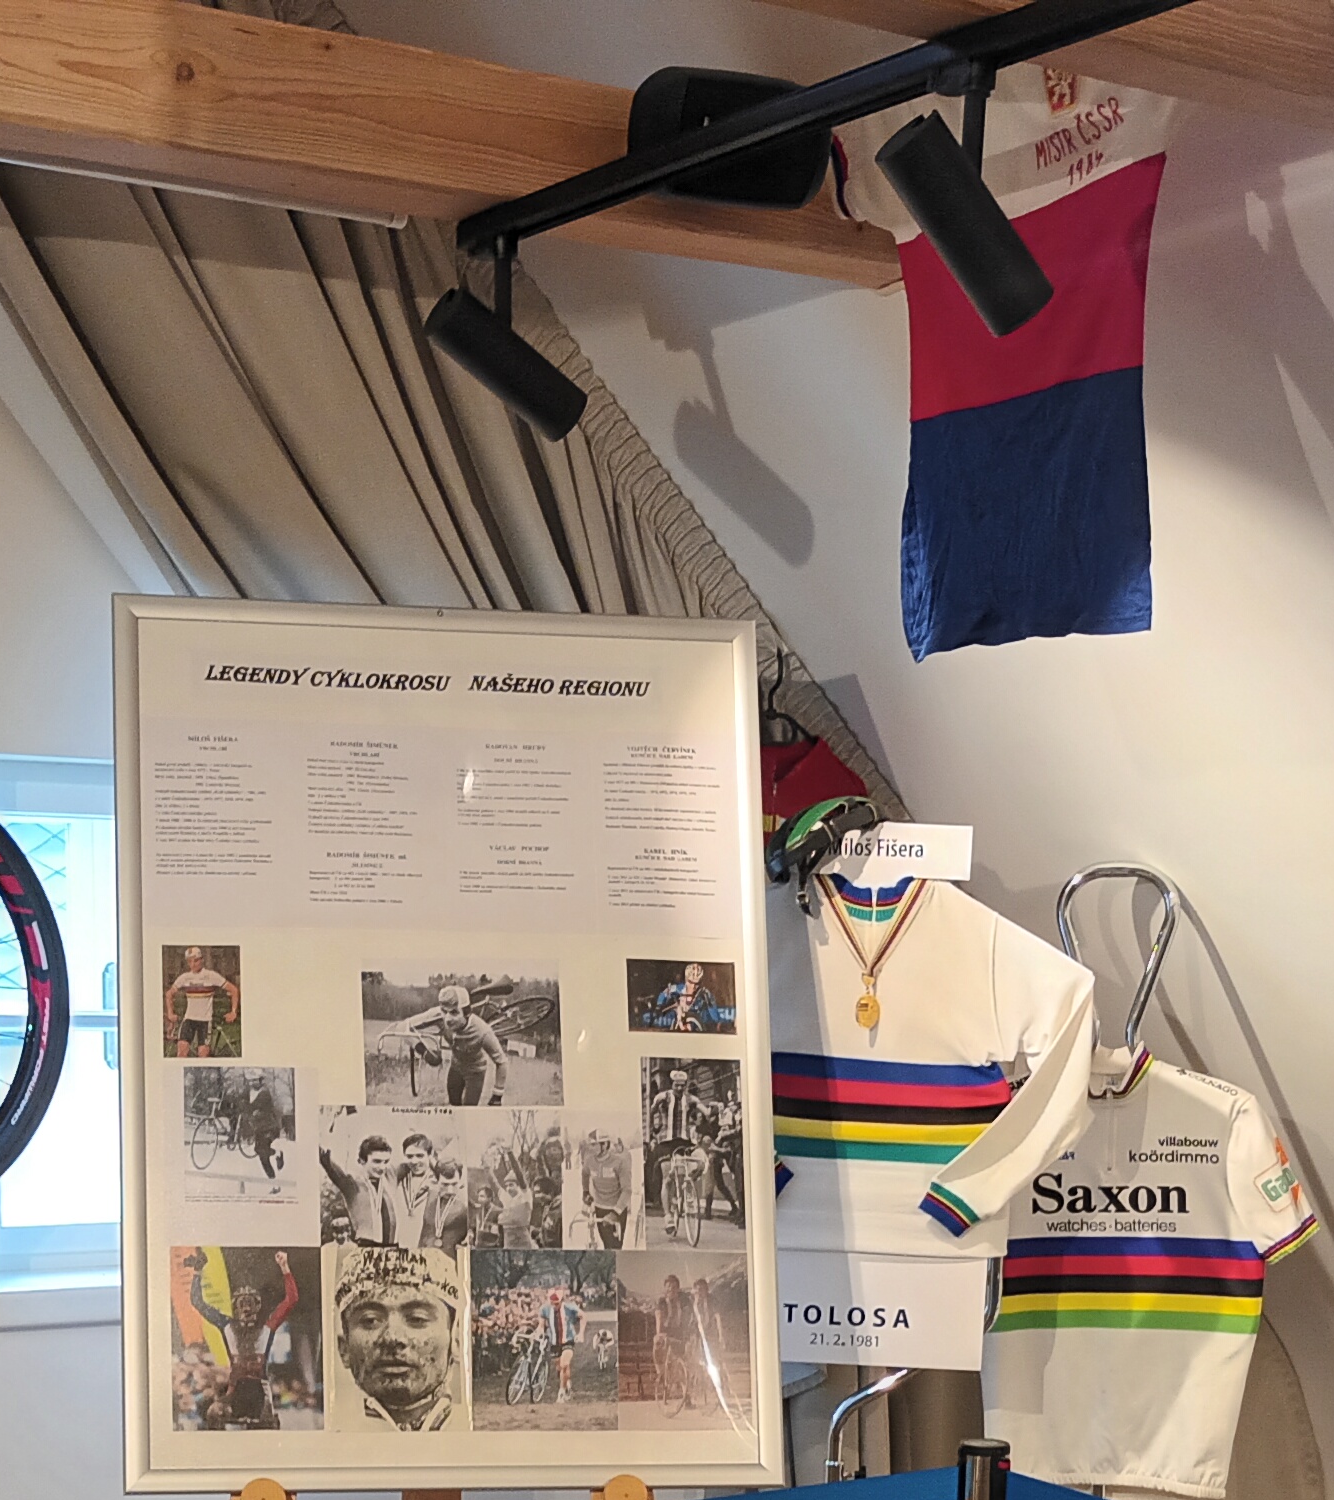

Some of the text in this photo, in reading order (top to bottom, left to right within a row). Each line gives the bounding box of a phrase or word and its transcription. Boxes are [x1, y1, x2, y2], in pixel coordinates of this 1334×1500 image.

[1035, 128, 1078, 170] MISTR
[205, 665, 651, 697] LEGENDY CYKLOKROSU NAŠEHO REGIONU
[877, 839, 924, 858] Fišera
[1128, 1149, 1220, 1164] koördimmo
[1031, 1172, 1190, 1215] Saxon
[1046, 1218, 1178, 1234] watches batteries
[784, 1304, 911, 1330] TOLOSA
